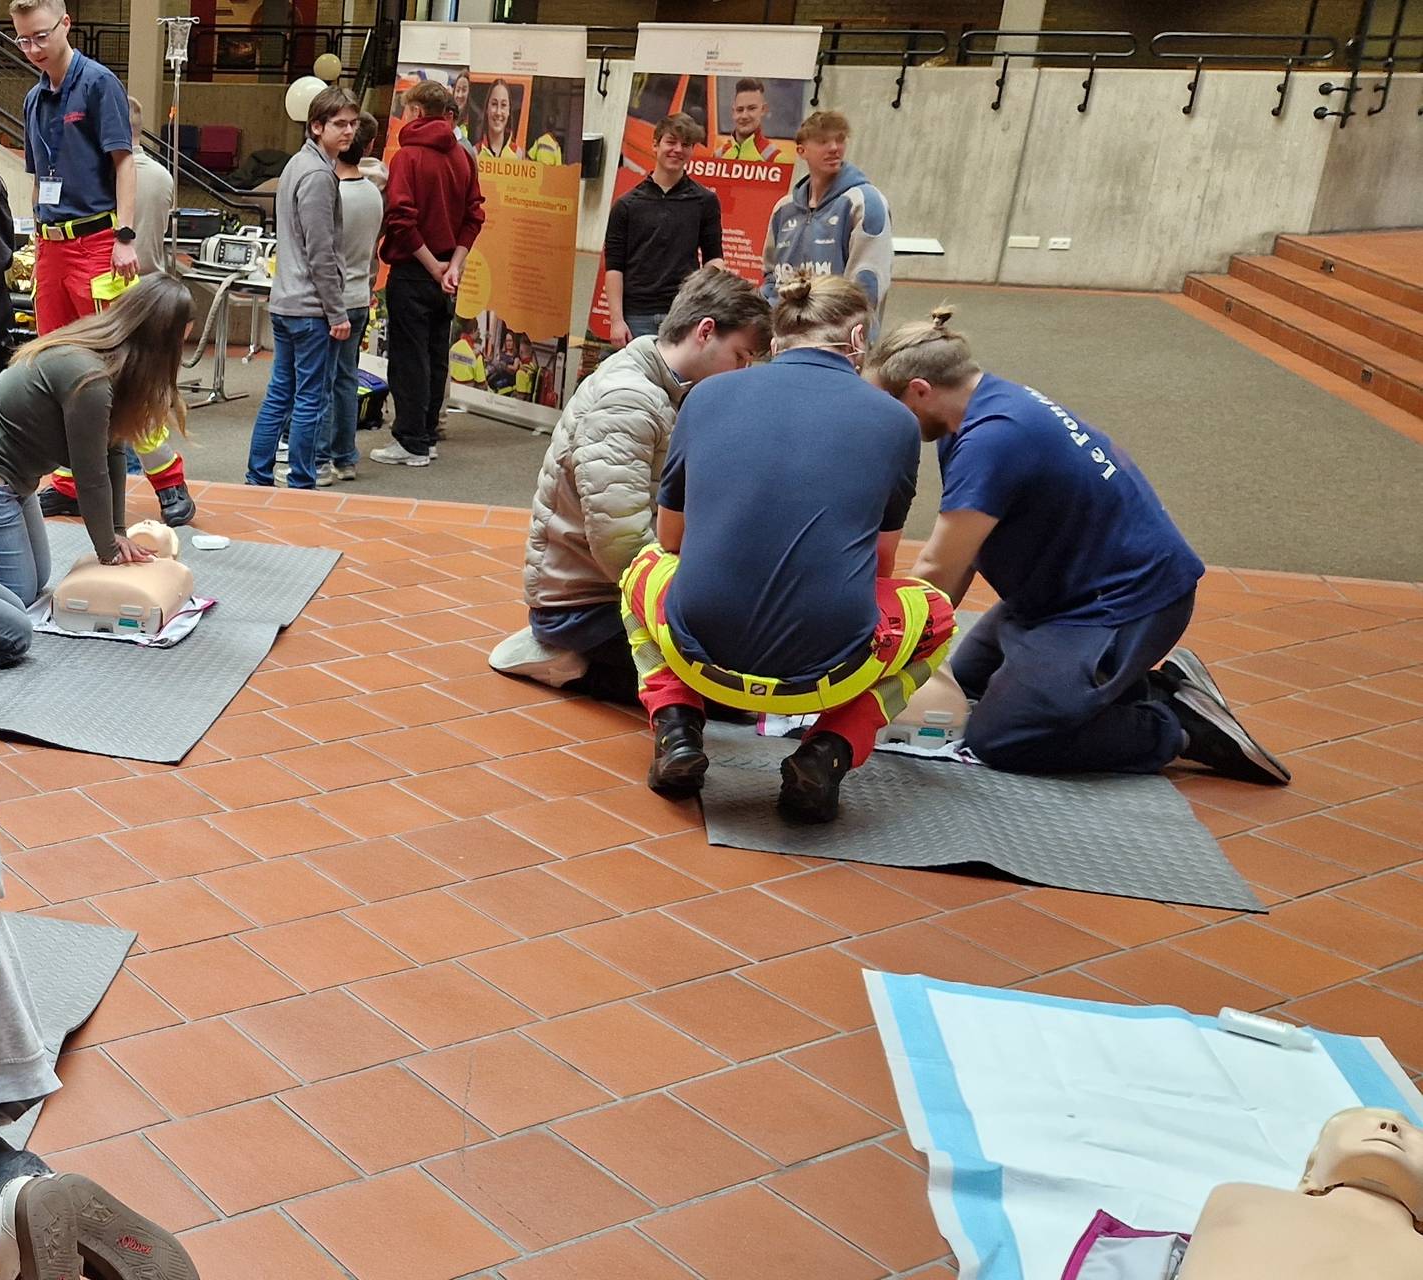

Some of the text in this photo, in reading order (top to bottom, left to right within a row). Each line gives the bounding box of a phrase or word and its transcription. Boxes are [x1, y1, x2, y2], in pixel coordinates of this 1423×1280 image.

[478, 160, 537, 179] SBILDUNG
[684, 160, 782, 183] USBILDUNG
[1090, 446, 1118, 481] Le
